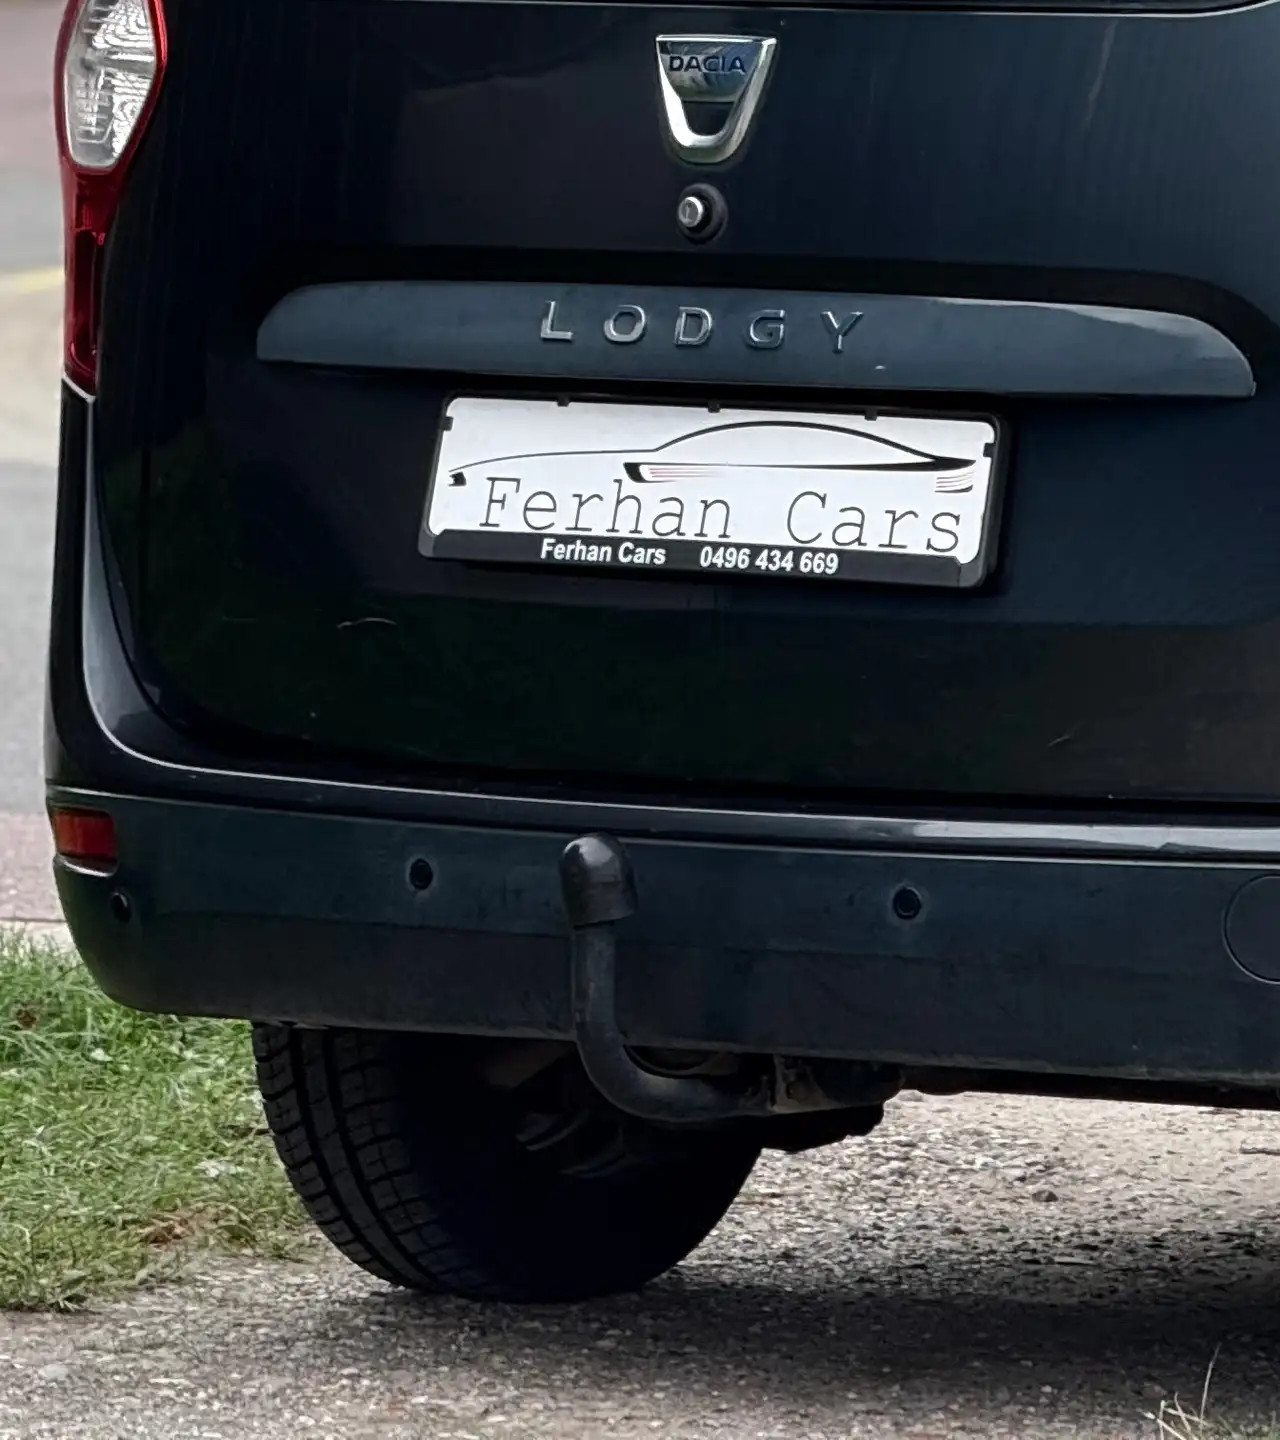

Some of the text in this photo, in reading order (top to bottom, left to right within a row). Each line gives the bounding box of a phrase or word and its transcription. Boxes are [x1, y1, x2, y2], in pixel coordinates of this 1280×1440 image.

[668, 55, 747, 73] DACIA
[540, 300, 864, 354] LODGY
[479, 476, 961, 553] Ferhan Cars
[540, 538, 839, 575] Ferhan Cars 0496 434 669
